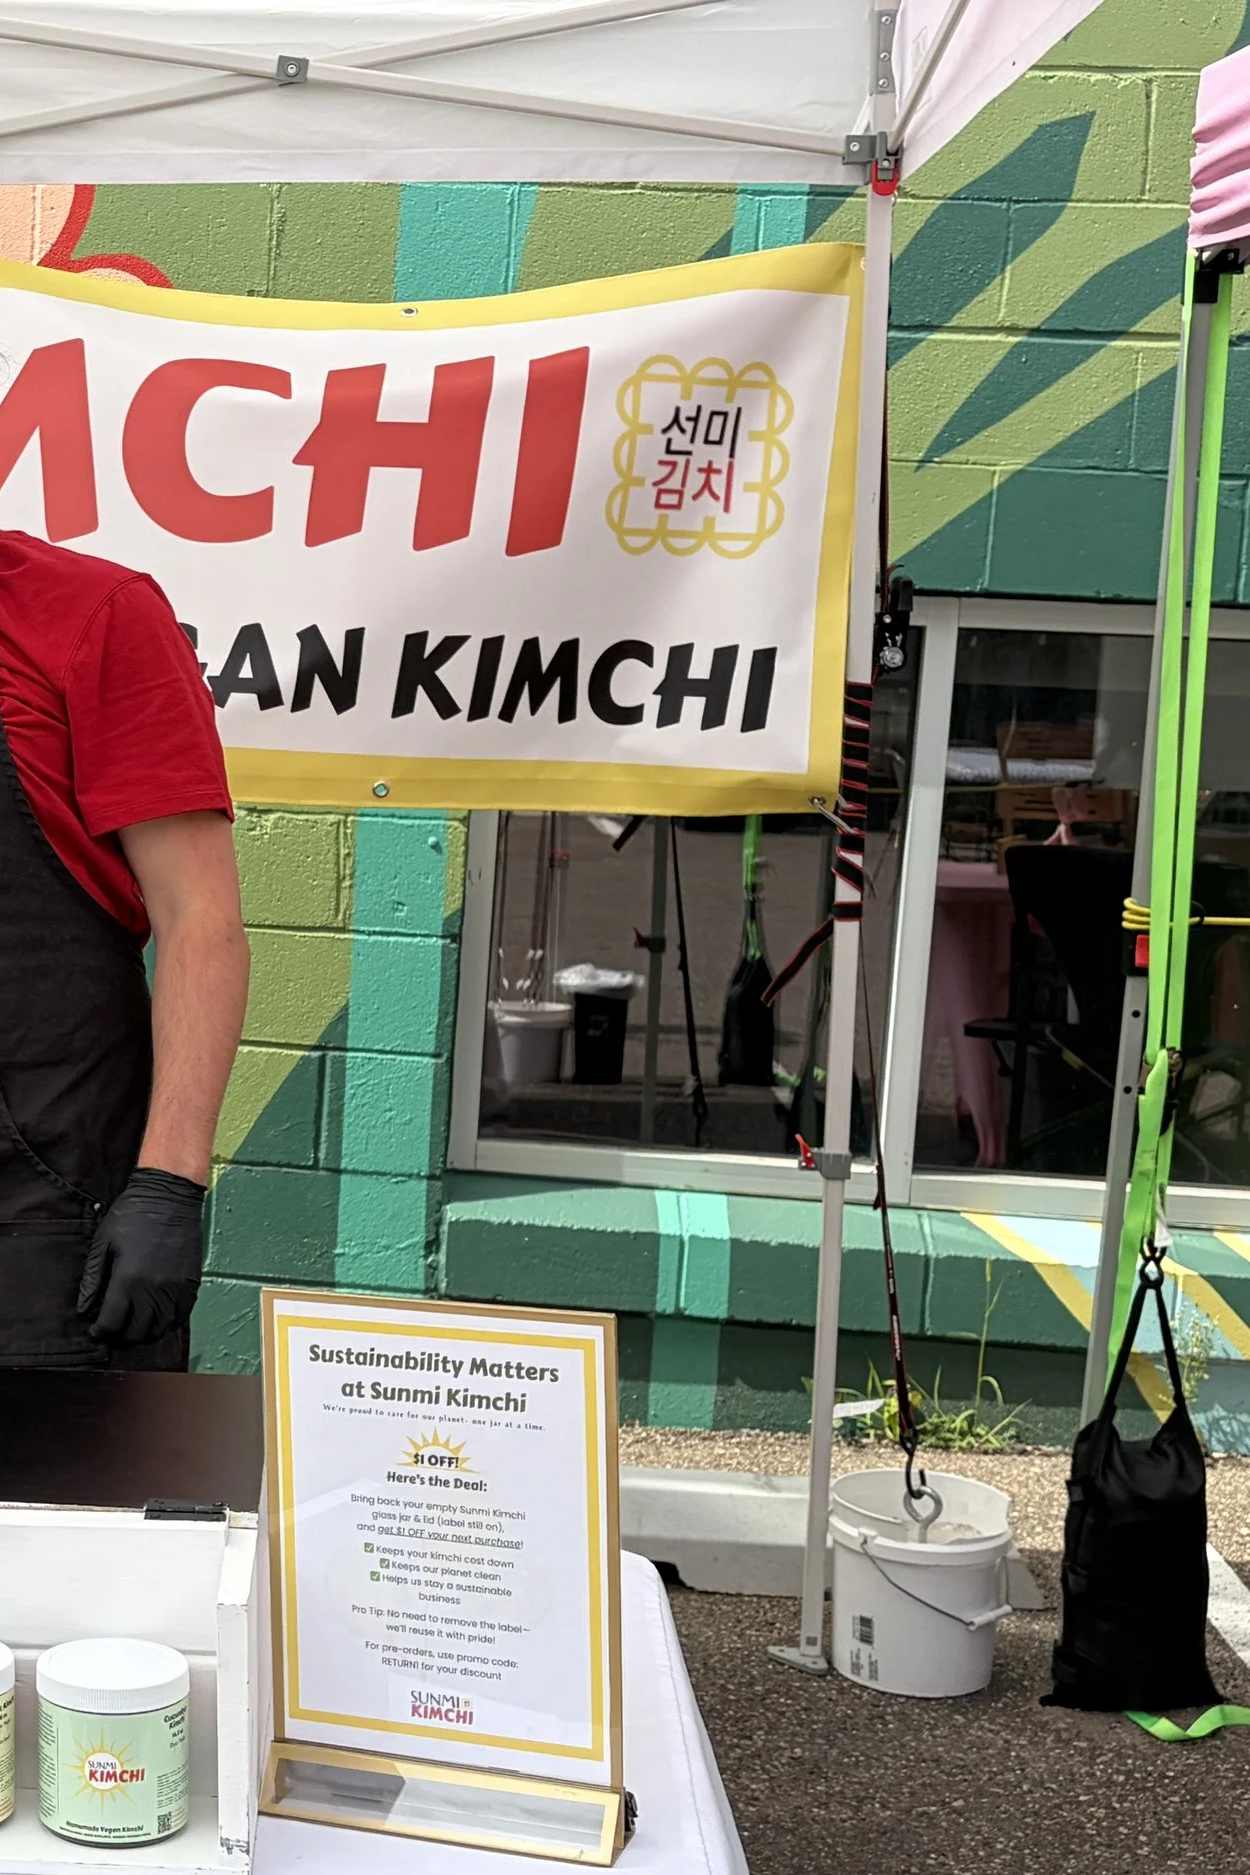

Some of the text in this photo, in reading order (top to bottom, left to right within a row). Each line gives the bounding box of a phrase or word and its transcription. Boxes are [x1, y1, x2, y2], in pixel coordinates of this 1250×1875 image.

[661, 404, 742, 460] 선미
[652, 457, 735, 514] 김치
[391, 629, 777, 733] KIMCHI
[309, 1344, 560, 1382] Sustainability Matters
[341, 1381, 527, 1413] at Sunmi Kimchi
[323, 1403, 346, 1412] We're
[375, 1408, 384, 1416] to
[407, 1411, 419, 1419] for
[489, 1419, 501, 1428] jar
[524, 1423, 546, 1431] time.
[413, 1452, 460, 1469] $1 OFF!
[387, 1471, 488, 1492] Here's the Deal:
[350, 1493, 526, 1521] Bring back your empty Sunmi Kimchi
[371, 1510, 397, 1521] glass
[398, 1512, 411, 1524] jar
[413, 1514, 421, 1523] &
[423, 1514, 435, 1525] lid
[437, 1515, 466, 1529] (label
[467, 1518, 484, 1530] still
[356, 1522, 376, 1532] and
[377, 1526, 394, 1536] get
[407, 1528, 426, 1538] OFF
[427, 1531, 449, 1542] your
[451, 1533, 473, 1545] next
[474, 1536, 524, 1550] purchase!
[375, 1545, 515, 1569] Keeps your kimchi cost down
[391, 1560, 502, 1582] Keeps our planet clean
[382, 1573, 513, 1597] Helps us stay a sustainable
[418, 1592, 461, 1605] business
[351, 1604, 367, 1615] Pro
[368, 1606, 385, 1617] Tip:
[387, 1608, 401, 1619] No
[402, 1611, 427, 1622] need
[428, 1614, 439, 1623] to
[440, 1618, 478, 1628] remove
[479, 1620, 496, 1631] the
[385, 1623, 496, 1645] we'll reuse it with pride!
[365, 1640, 519, 1669] For pre-orders, use promo code:
[421, 1661, 435, 1672] for
[436, 1665, 458, 1675] your
[460, 1667, 502, 1681] discount
[410, 1690, 461, 1709] SUNMI
[410, 1704, 474, 1725] KIMCHI
[88, 1760, 117, 1770] SUNMI
[88, 1768, 145, 1783] KIMCHI
